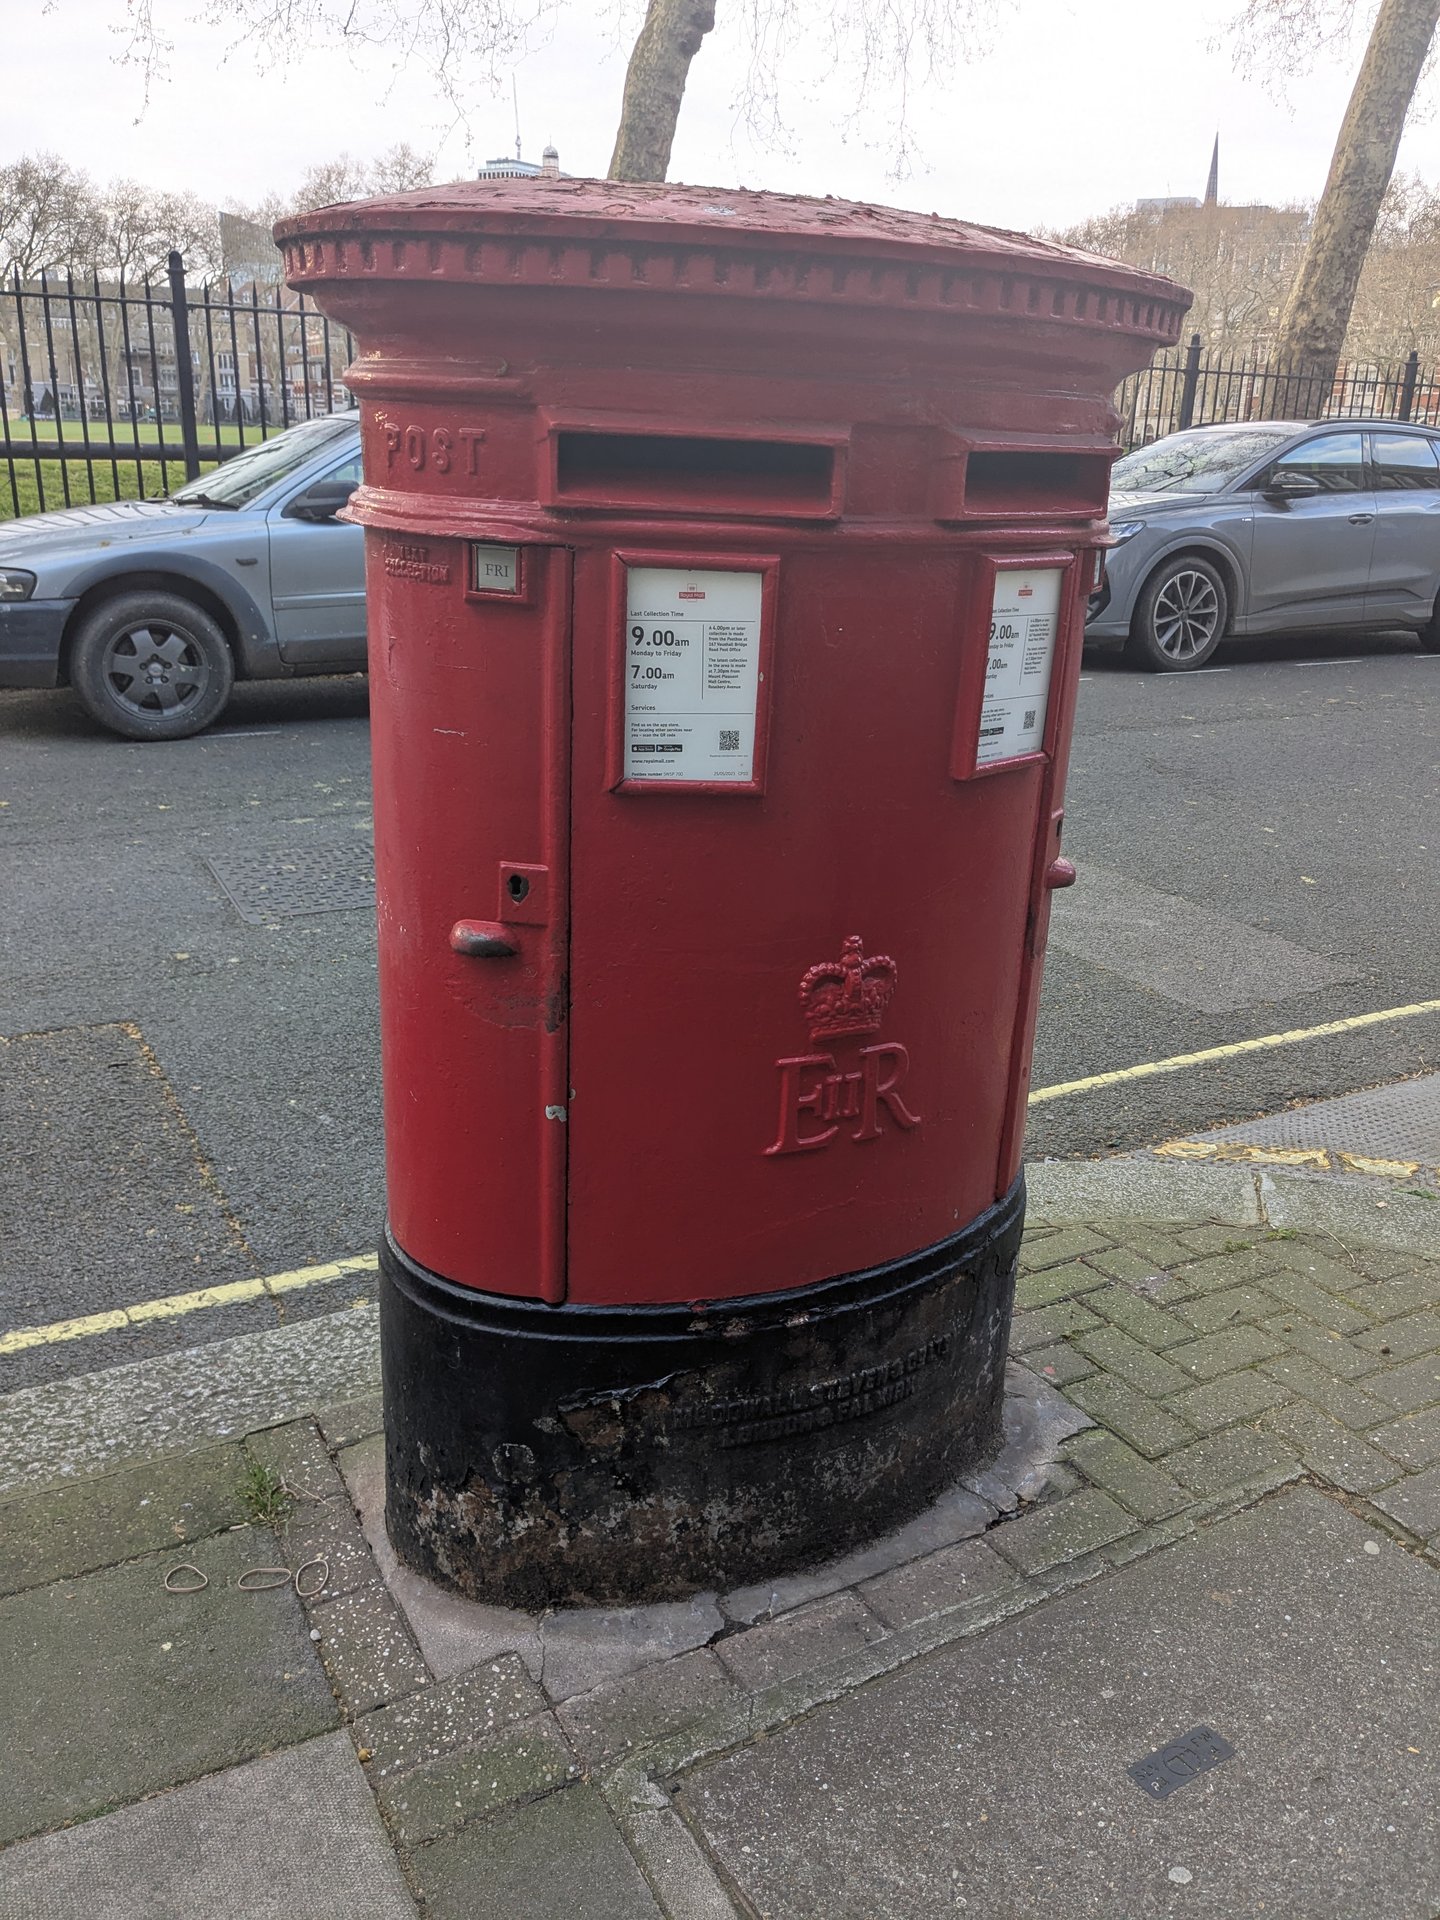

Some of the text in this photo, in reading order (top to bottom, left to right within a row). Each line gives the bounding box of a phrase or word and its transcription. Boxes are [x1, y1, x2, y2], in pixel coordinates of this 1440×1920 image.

[384, 422, 485, 475] POST
[385, 557, 449, 582] COLLECTION
[485, 563, 509, 578] FRI
[632, 626, 690, 646] 9.00am
[631, 664, 675, 680] 7.00am
